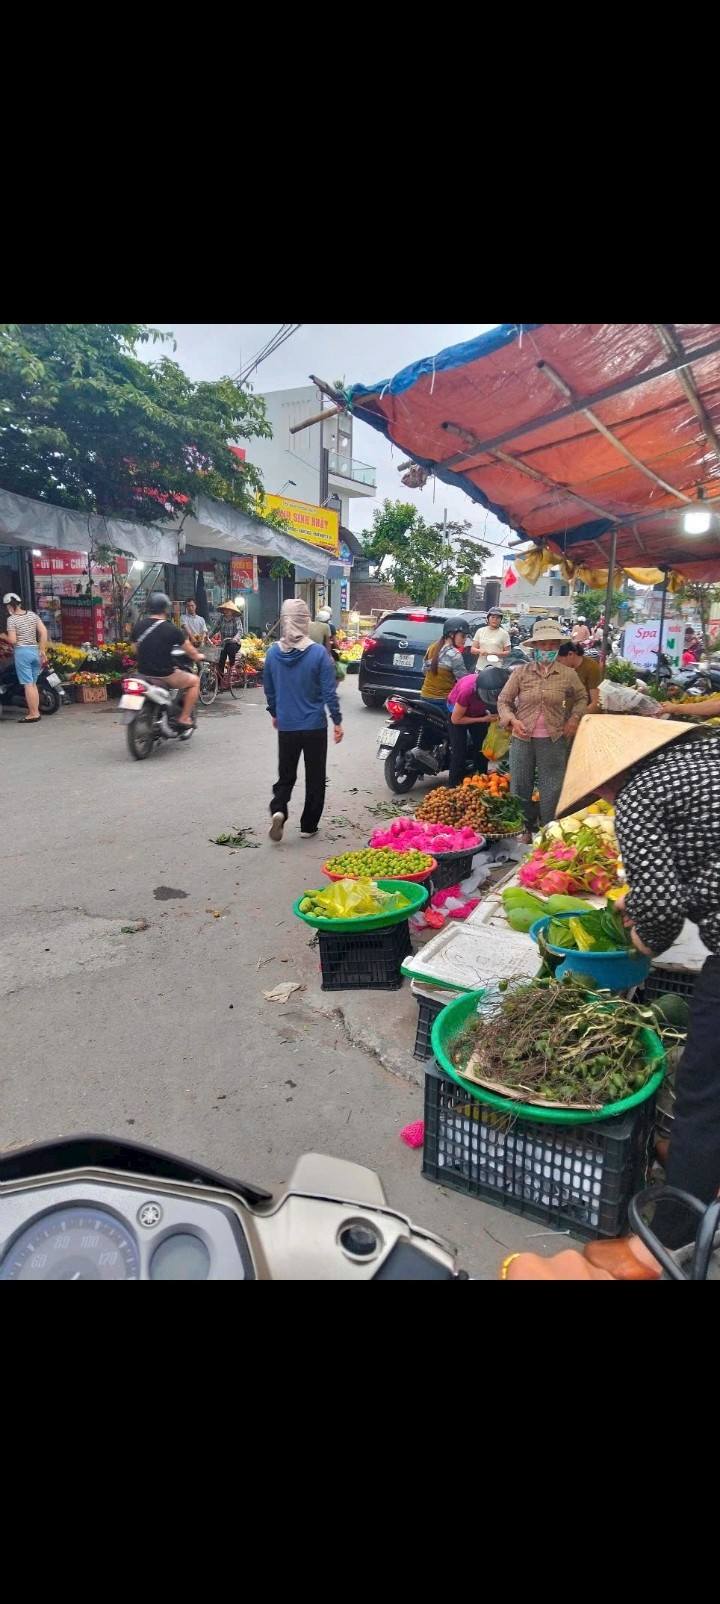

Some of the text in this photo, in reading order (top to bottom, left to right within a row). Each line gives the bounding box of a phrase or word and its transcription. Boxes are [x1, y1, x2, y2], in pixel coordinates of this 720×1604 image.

[635, 627, 657, 639] Spa
[80, 1235, 100, 1249] 100
[31, 1251, 118, 1269] 60 120
